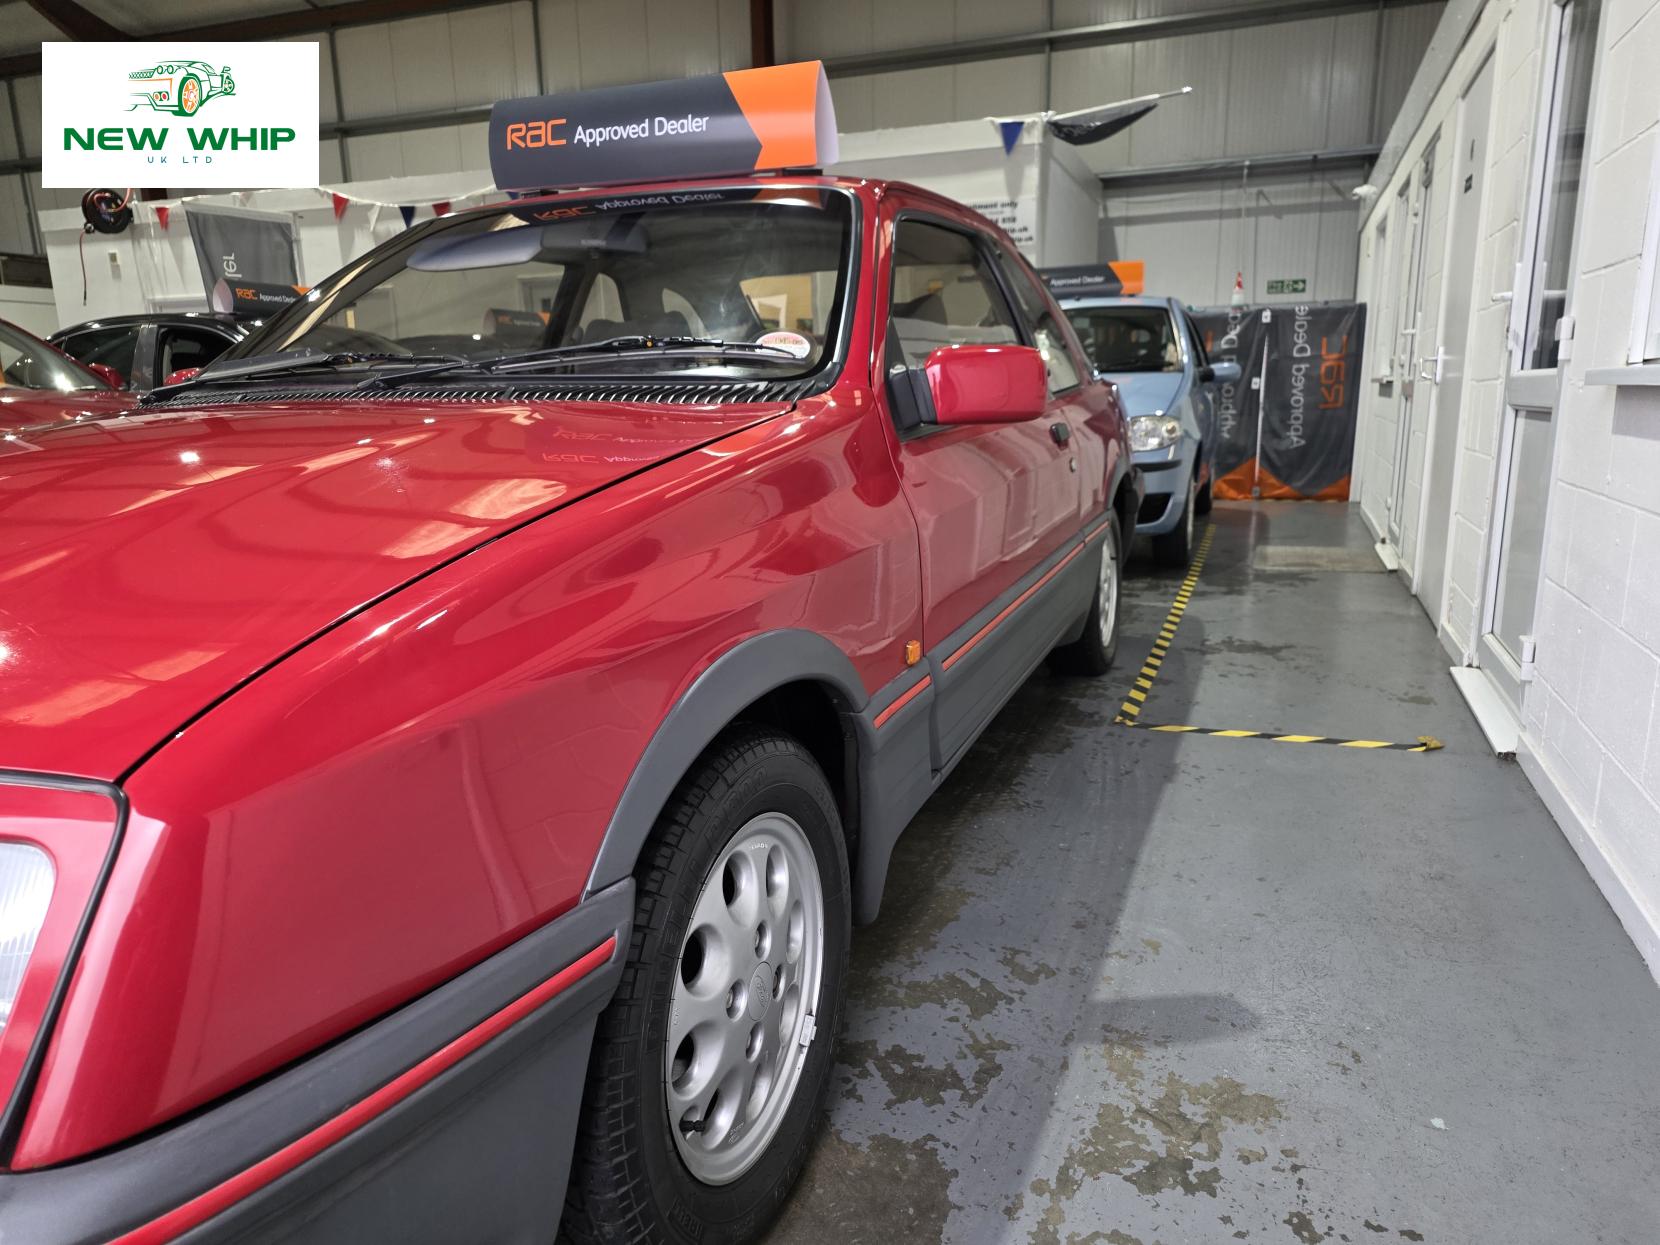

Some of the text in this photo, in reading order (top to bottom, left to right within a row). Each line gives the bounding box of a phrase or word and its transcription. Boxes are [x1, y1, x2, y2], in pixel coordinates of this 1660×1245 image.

[573, 119, 649, 148] Approved
[655, 114, 709, 136] Dealer
[1050, 276, 1081, 287] Approved
